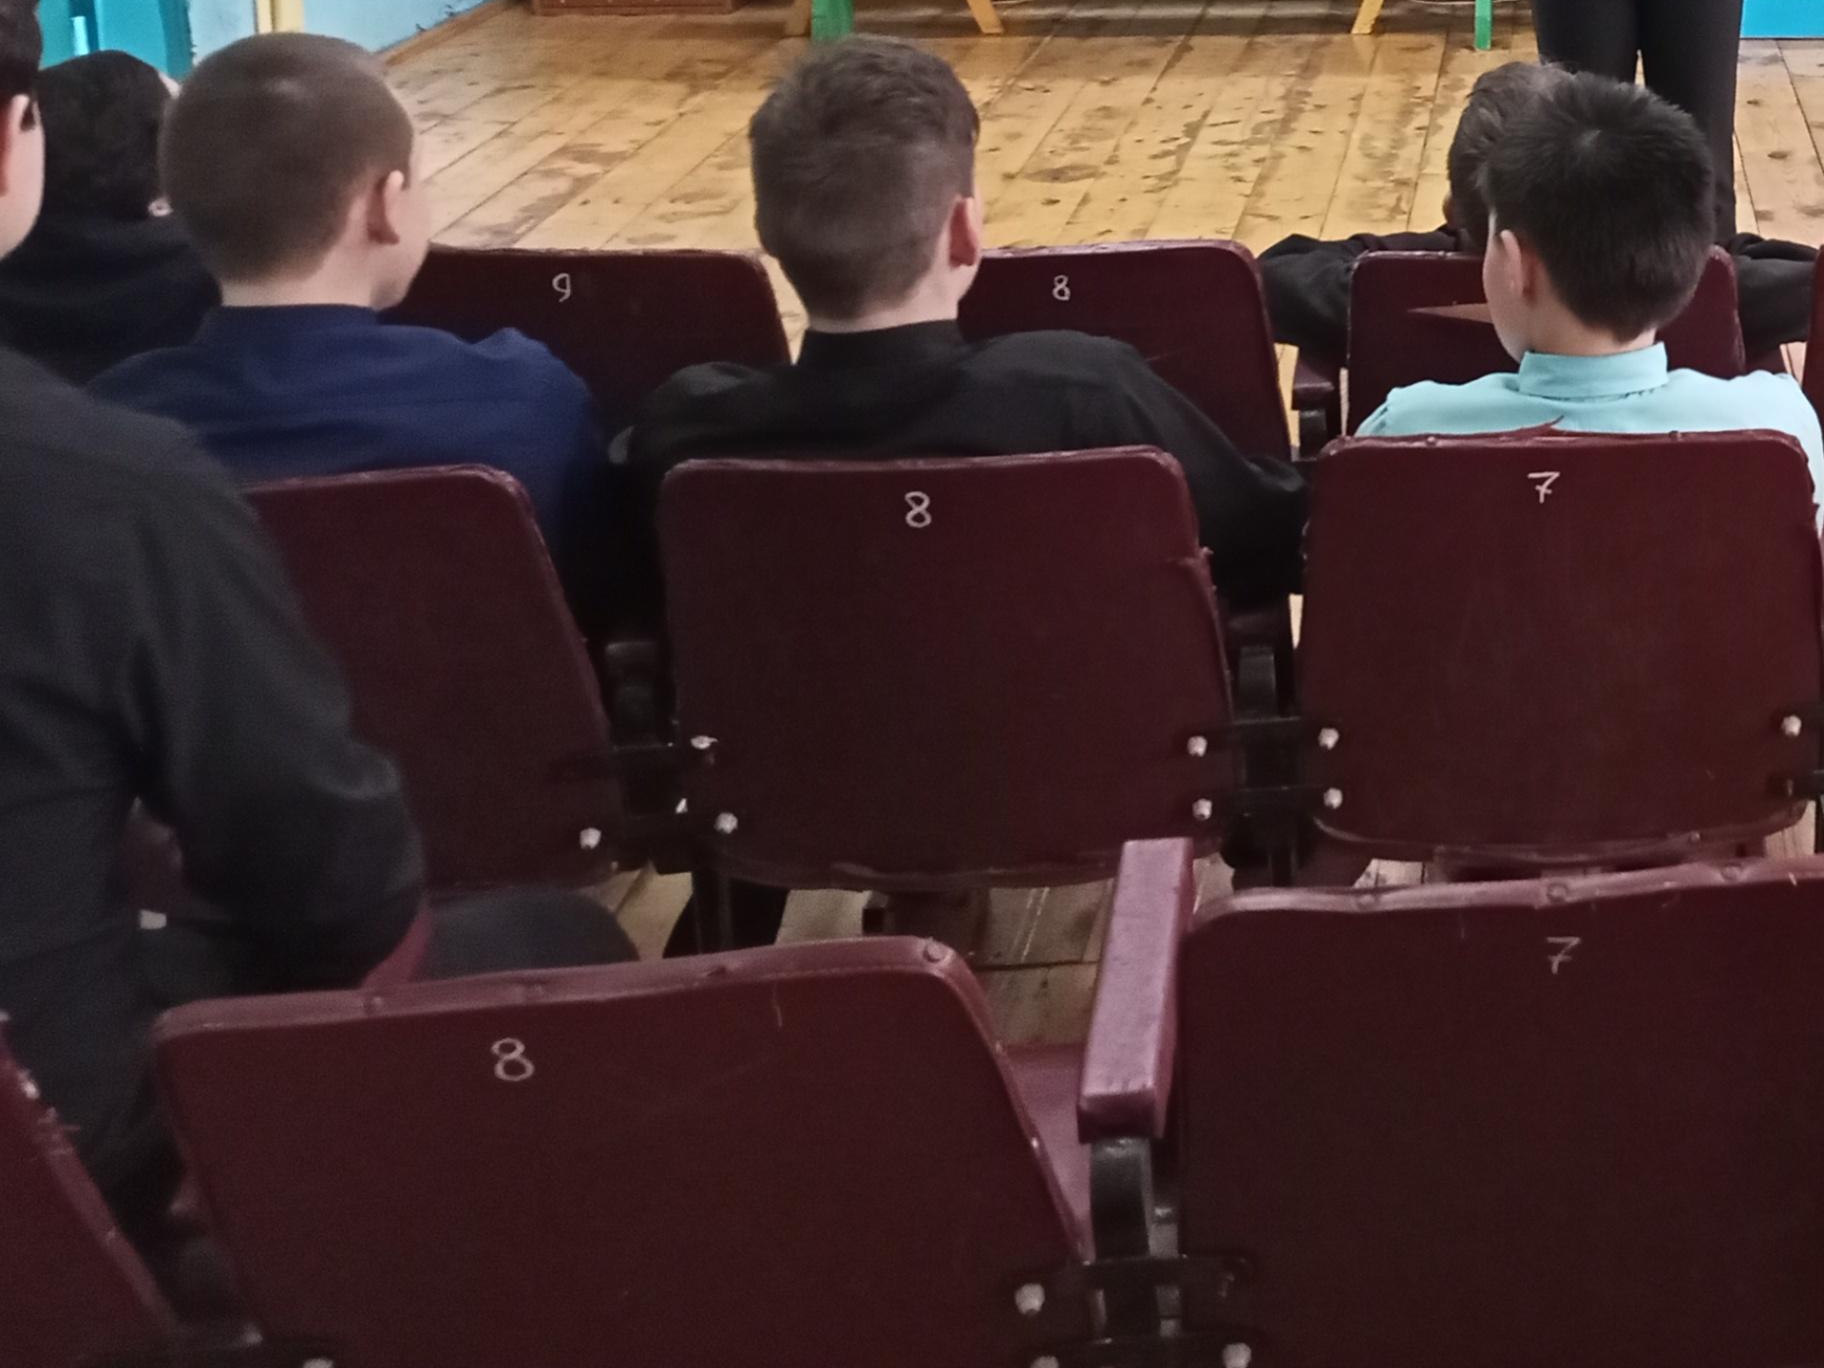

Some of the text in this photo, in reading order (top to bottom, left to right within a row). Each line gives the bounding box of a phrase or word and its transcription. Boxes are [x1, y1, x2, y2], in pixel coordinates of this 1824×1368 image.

[550, 272, 573, 304] 9
[1052, 274, 1072, 303] 8
[1526, 470, 1562, 505] 7
[903, 489, 933, 530] 8
[1545, 935, 1582, 976] 7
[489, 1036, 536, 1083] 8
